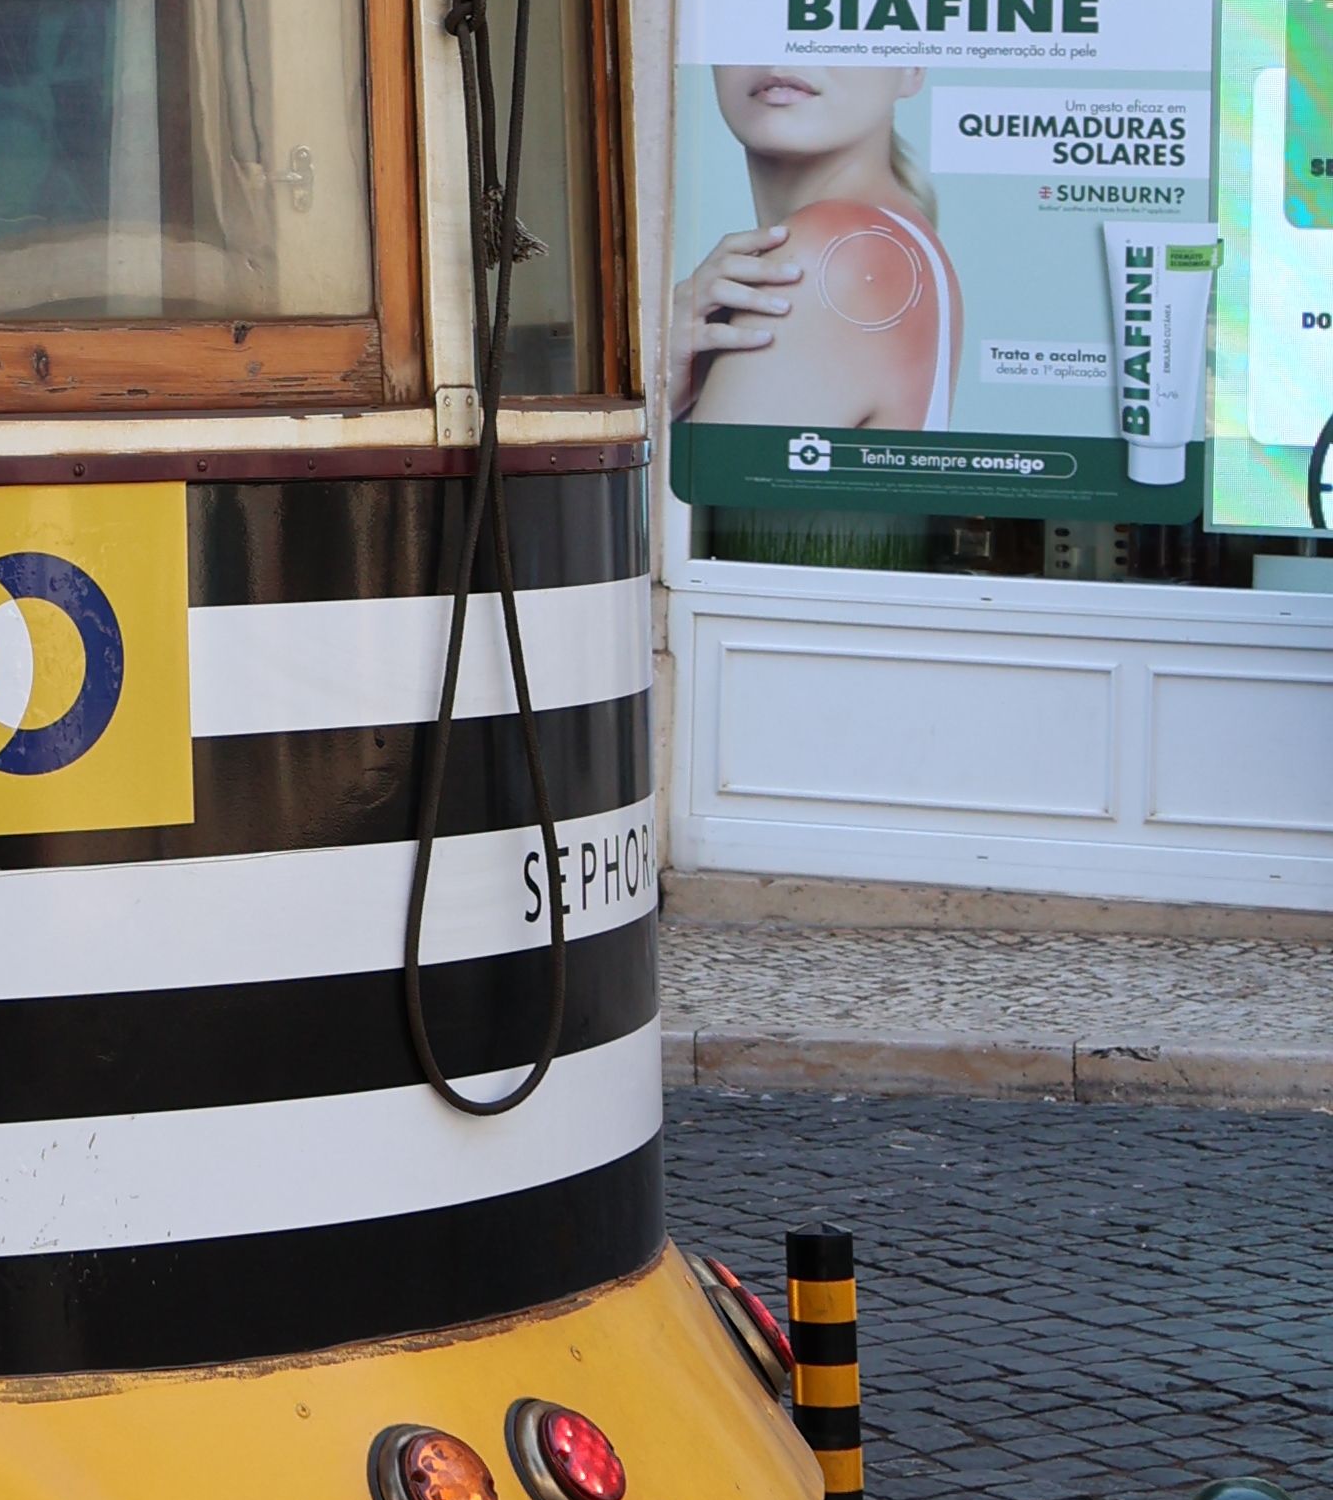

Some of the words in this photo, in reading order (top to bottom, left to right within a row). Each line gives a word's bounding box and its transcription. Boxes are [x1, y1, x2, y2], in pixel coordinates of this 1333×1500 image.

[784, 40, 869, 55] Medicamento
[871, 42, 943, 58] especialista
[945, 46, 963, 56] na
[965, 44, 1045, 59] regeneração
[1049, 43, 1067, 58] da
[1069, 43, 1098, 60] pele
[1065, 99, 1087, 113] Um
[1090, 101, 1124, 116] gesto
[1126, 98, 1164, 114] eficaz
[1167, 104, 1187, 114] em
[958, 113, 1187, 140] QUEIMADURAS
[1051, 141, 1187, 167] SOLARES
[1056, 184, 1186, 205] SUNBURN?
[1121, 246, 1154, 437] BIAFINE
[989, 346, 1031, 361] Trata
[1035, 351, 1045, 361] e
[1049, 348, 1108, 363] acalma
[996, 362, 1029, 376] desde
[1030, 367, 1039, 376] a
[1053, 364, 1107, 380] aplicação
[859, 448, 906, 466] Tenha
[909, 452, 967, 472] sempre
[971, 452, 1045, 475] consigo
